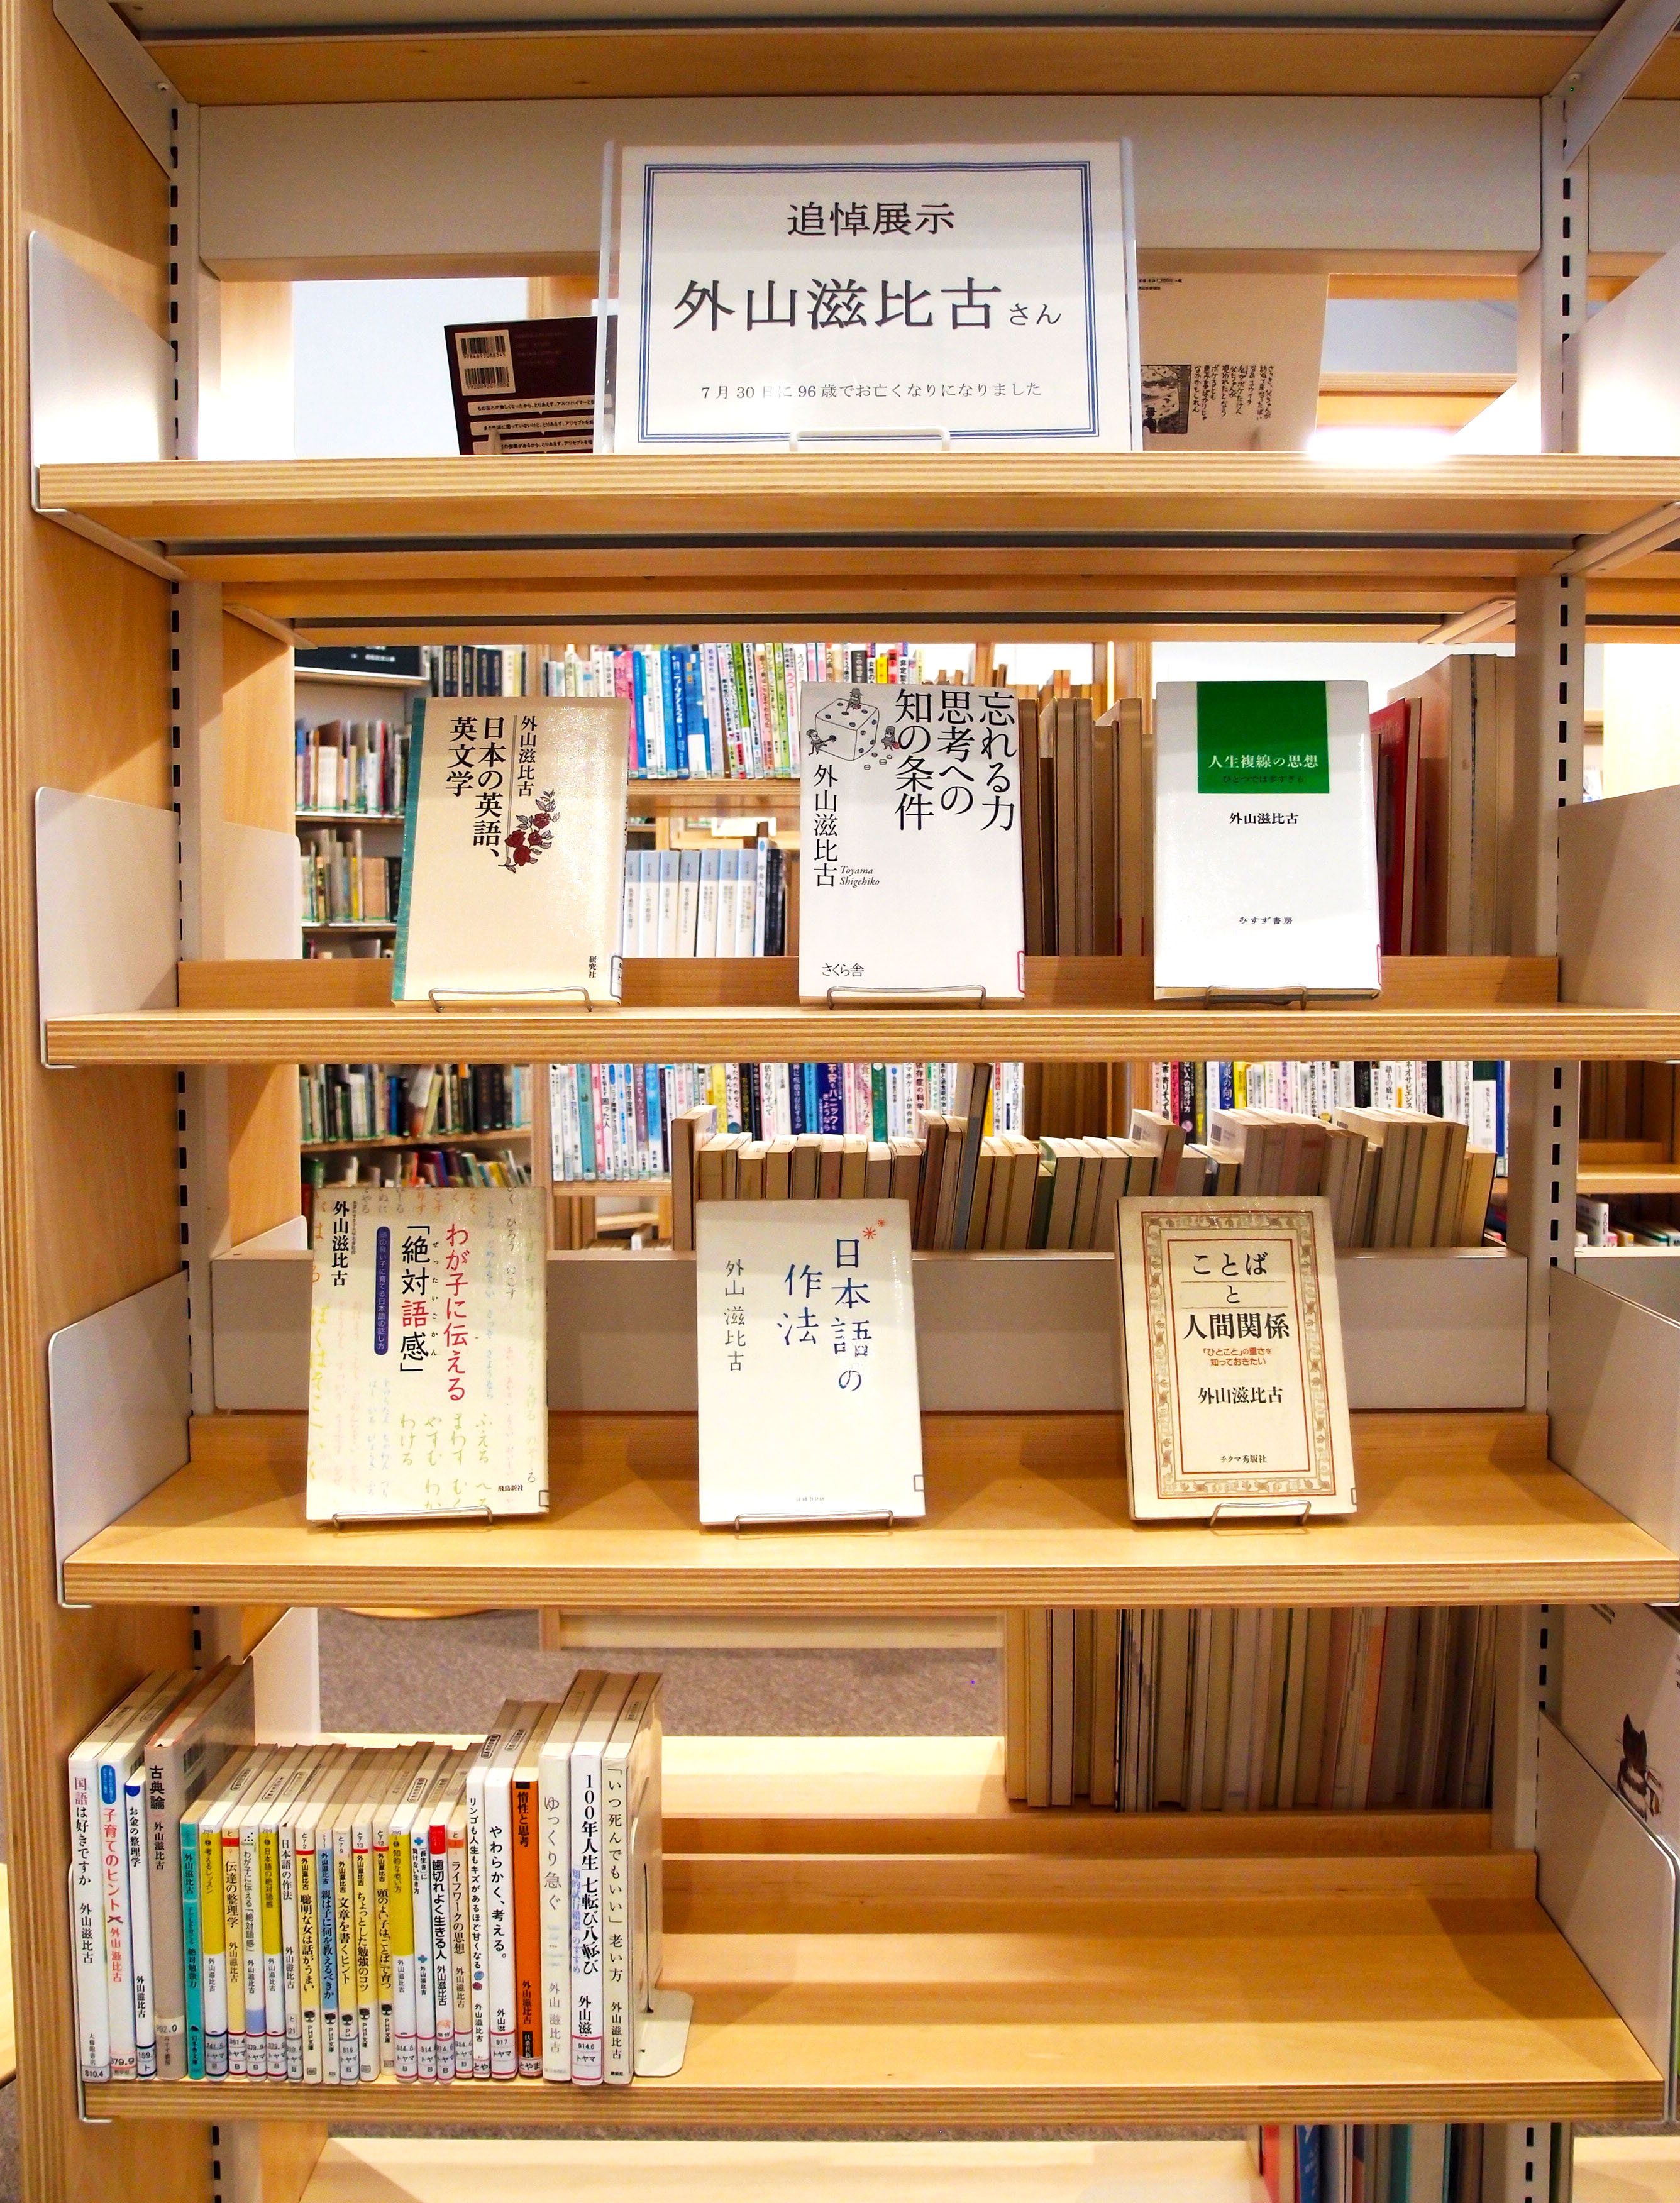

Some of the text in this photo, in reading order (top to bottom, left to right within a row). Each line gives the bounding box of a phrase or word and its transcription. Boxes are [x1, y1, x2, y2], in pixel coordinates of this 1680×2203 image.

[787, 201, 956, 237] 追悼展示
[445, 716, 478, 797] 英文学
[517, 715, 538, 797] 外山滋比古
[894, 688, 935, 831] 知の条件
[937, 689, 975, 815] 思考への
[978, 690, 1017, 831] 忘れる力
[1208, 754, 1318, 769] 人生複線の思想
[473, 717, 506, 858] 日本の英語、
[1223, 774, 1305, 784] ひとつでは多すぎる
[813, 763, 838, 888] 外山滋比古
[1229, 812, 1299, 825] 外山滋比古
[839, 876, 880, 888] Shigehiko
[840, 865, 873, 876] Toyama
[1239, 915, 1293, 925] みすず書房
[821, 963, 865, 978] さくら舎
[331, 1200, 350, 1287] 外山滋比古
[1193, 1252, 1268, 1277] ことば
[399, 1225, 431, 1372] 「絶対語感」
[431, 1240, 439, 1357] ぜったいごかん
[443, 1223, 469, 1402] わが子に伝える
[724, 1259, 746, 1372] 外山滋比古
[777, 1263, 823, 1346] 作法
[831, 1238, 871, 1393] 日本語の
[1227, 1284, 1241, 1305] と
[1182, 1312, 1290, 1340] 人間関係
[1202, 1346, 1272, 1357] 「ひとこと」の重さを
[1210, 1357, 1267, 1367] 知っておきたい
[1197, 1386, 1283, 1405] 外山滋比古
[1220, 1454, 1267, 1464] チクマ秀版社
[498, 1484, 523, 1493] 飛鳥新社
[149, 1765, 166, 1810] 古典論
[74, 1777, 91, 1886] 国語は好きですか
[129, 1806, 141, 1868] お金の整理学
[154, 1821, 165, 1870] 外山滋比古
[544, 1796, 562, 1911] ゆっくり急ぐ
[104, 1808, 121, 1912] 子育てのヒント
[184, 1853, 194, 1895] 外山滋比古
[204, 1848, 213, 1895] 考えるレッスン
[281, 1839, 292, 1901] 日本語の作法
[301, 1857, 309, 1891] 外山滋比古
[321, 1852, 329, 1885] 外山滋比古
[338, 1860, 346, 1894] 外山滋比古
[356, 1855, 365, 1887] 外山滋比古
[377, 1853, 385, 1882] 外山滋比古
[392, 1849, 402, 1894] 知的な老い方
[607, 1767, 623, 1982] 「いつ死んでもいい」老い方
[225, 1860, 239, 1928] 伝達の整理学
[243, 1850, 255, 1952] わが子に伝える「絶対語感」
[469, 1797, 482, 1969] リンゴも人生もキズがあるほど甘くなる
[489, 1826, 507, 1959] やわらかく、考える。
[431, 1859, 448, 1960] 歯切れよく生きる人
[451, 1861, 465, 1955] ライフワークの思想
[80, 1903, 93, 1964] 外山滋比古
[109, 1928, 122, 1983] 外山滋比古
[300, 1894, 314, 1992] 聡明な女は話がうまい
[321, 1890, 334, 1999] 親は子に何を教えるべきか
[338, 1897, 350, 1984] 文章を書くヒント
[357, 1892, 370, 1992] ちょっとした勉強のコツ
[208, 1958, 216, 1992] 外山滋比古
[229, 1941, 239, 1983] 外山滋比古
[247, 1959, 255, 1994] 外山滋比古
[268, 1958, 276, 1992] 外山滋比古
[285, 1946, 295, 1989] 外山滋比古
[397, 1959, 406, 1993] 外山滋比古
[136, 1975, 146, 2018] 外山滋比古
[436, 1965, 448, 2006] 外山滋比古
[456, 1967, 465, 2009] 外山滋比古
[522, 1980, 532, 2025] 外山滋比古
[475, 2003, 484, 2043] 外山滋比古
[548, 1982, 561, 2053] 外山滋比古
[611, 2001, 623, 2060] 外山滋比古
[84, 2069, 104, 2078] 810.4
[519, 2062, 541, 2071] とやま
[576, 2055, 596, 2063] トヤマ
